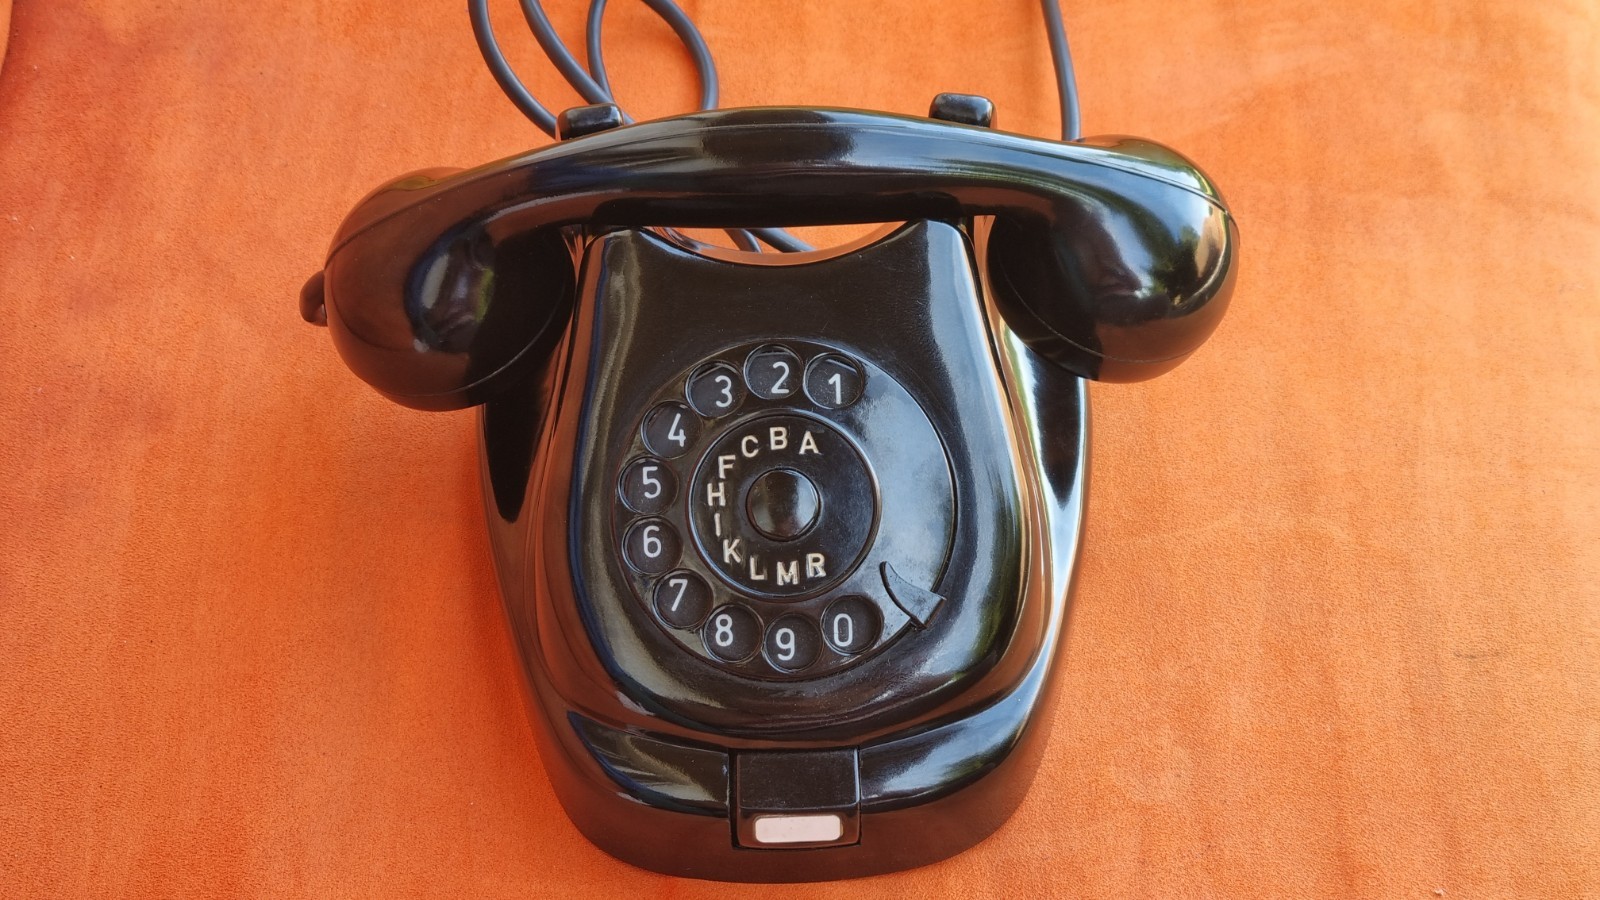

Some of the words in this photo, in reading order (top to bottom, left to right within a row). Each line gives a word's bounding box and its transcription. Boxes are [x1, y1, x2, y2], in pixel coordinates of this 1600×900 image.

[715, 375, 732, 408] 3
[771, 361, 789, 394] 2
[828, 373, 842, 405] 1
[667, 413, 686, 447] 4
[769, 427, 788, 450] B
[799, 430, 819, 454] A
[741, 435, 759, 458] C
[718, 455, 736, 479] F
[642, 466, 662, 499] 5
[707, 482, 726, 506] H
[714, 513, 721, 537] I
[643, 526, 662, 558] 6
[723, 538, 741, 564] K
[750, 557, 765, 581] L
[776, 561, 799, 586] M
[807, 553, 826, 578] R
[669, 579, 689, 612] 7
[715, 614, 734, 647] 8
[775, 628, 796, 661] 9
[833, 613, 853, 647] 0
